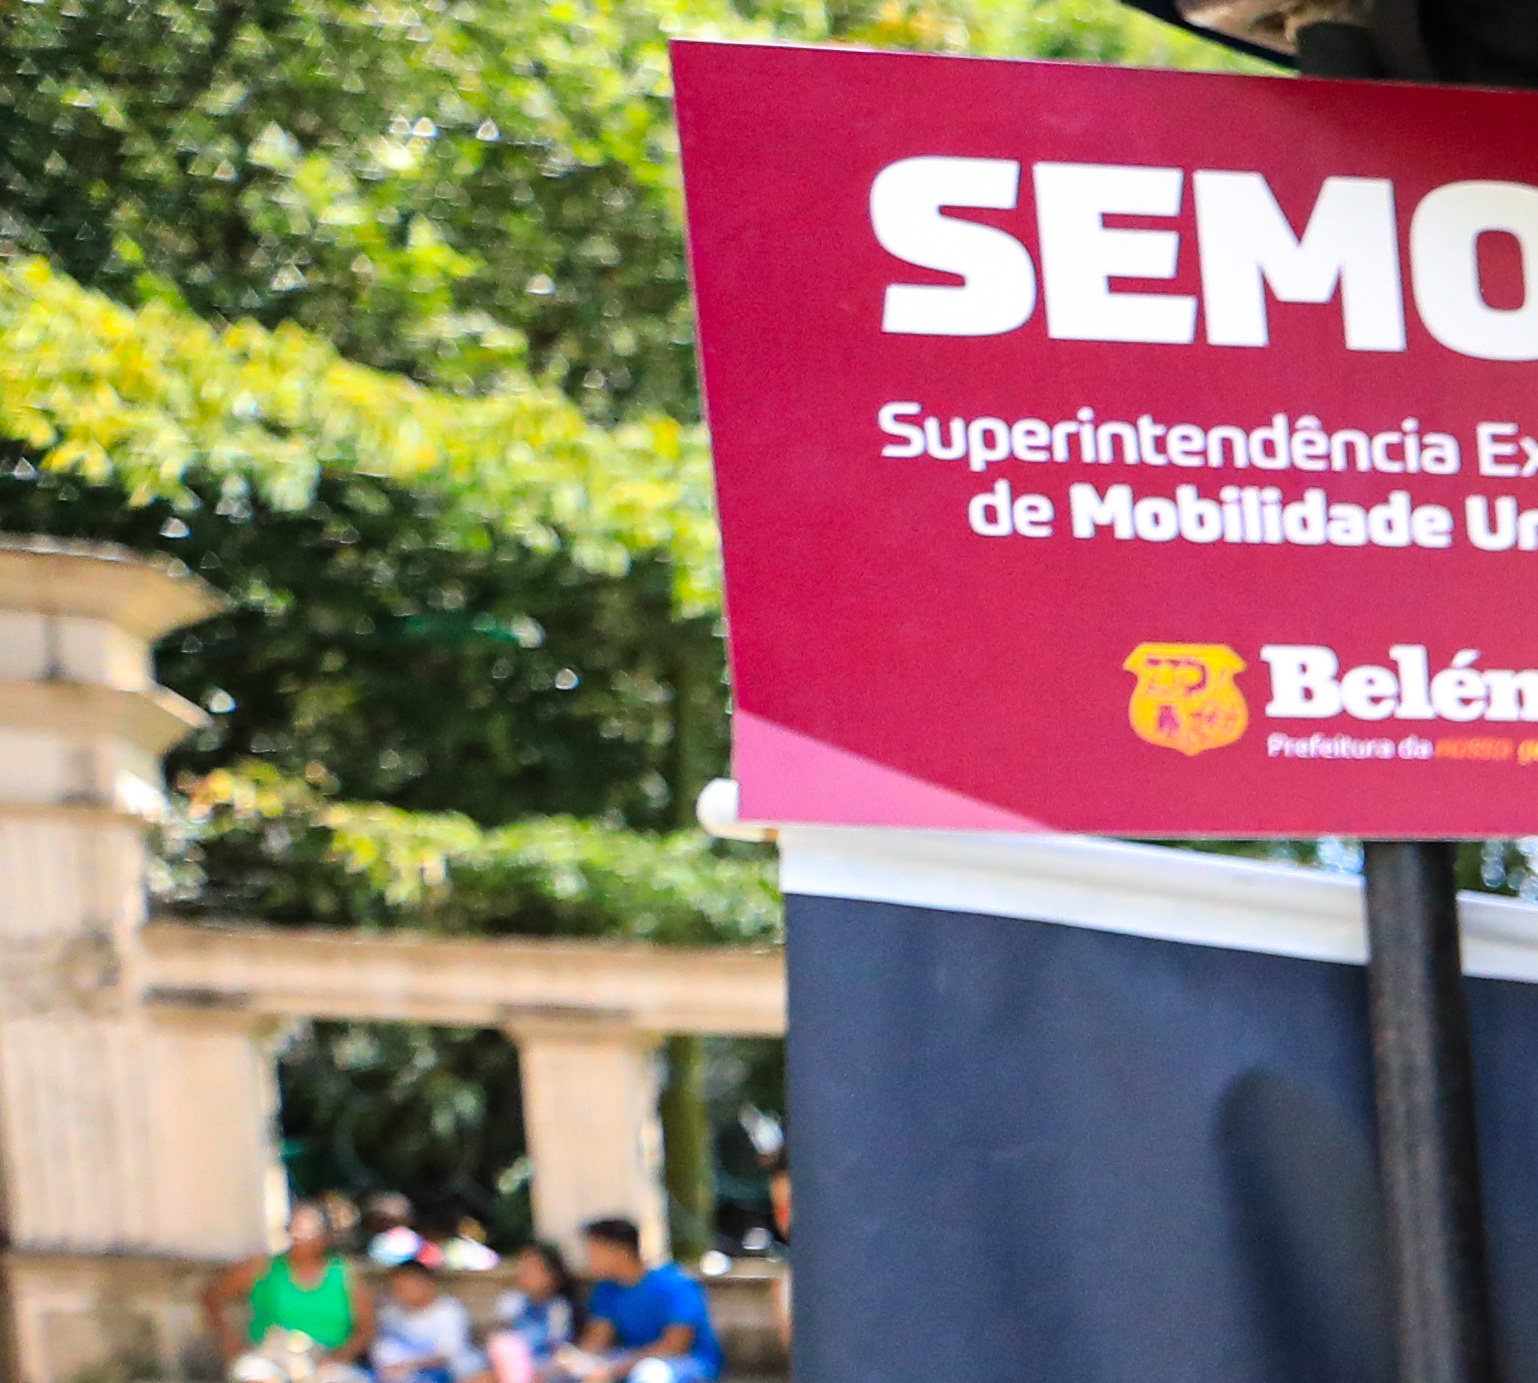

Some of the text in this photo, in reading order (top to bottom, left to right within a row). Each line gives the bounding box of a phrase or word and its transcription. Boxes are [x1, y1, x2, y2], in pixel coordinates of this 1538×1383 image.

[878, 402, 1460, 475] Superintendência
[968, 480, 1054, 538] de
[1069, 484, 1453, 549] Mobilidade
[1267, 732, 1396, 759] Prefeitura
